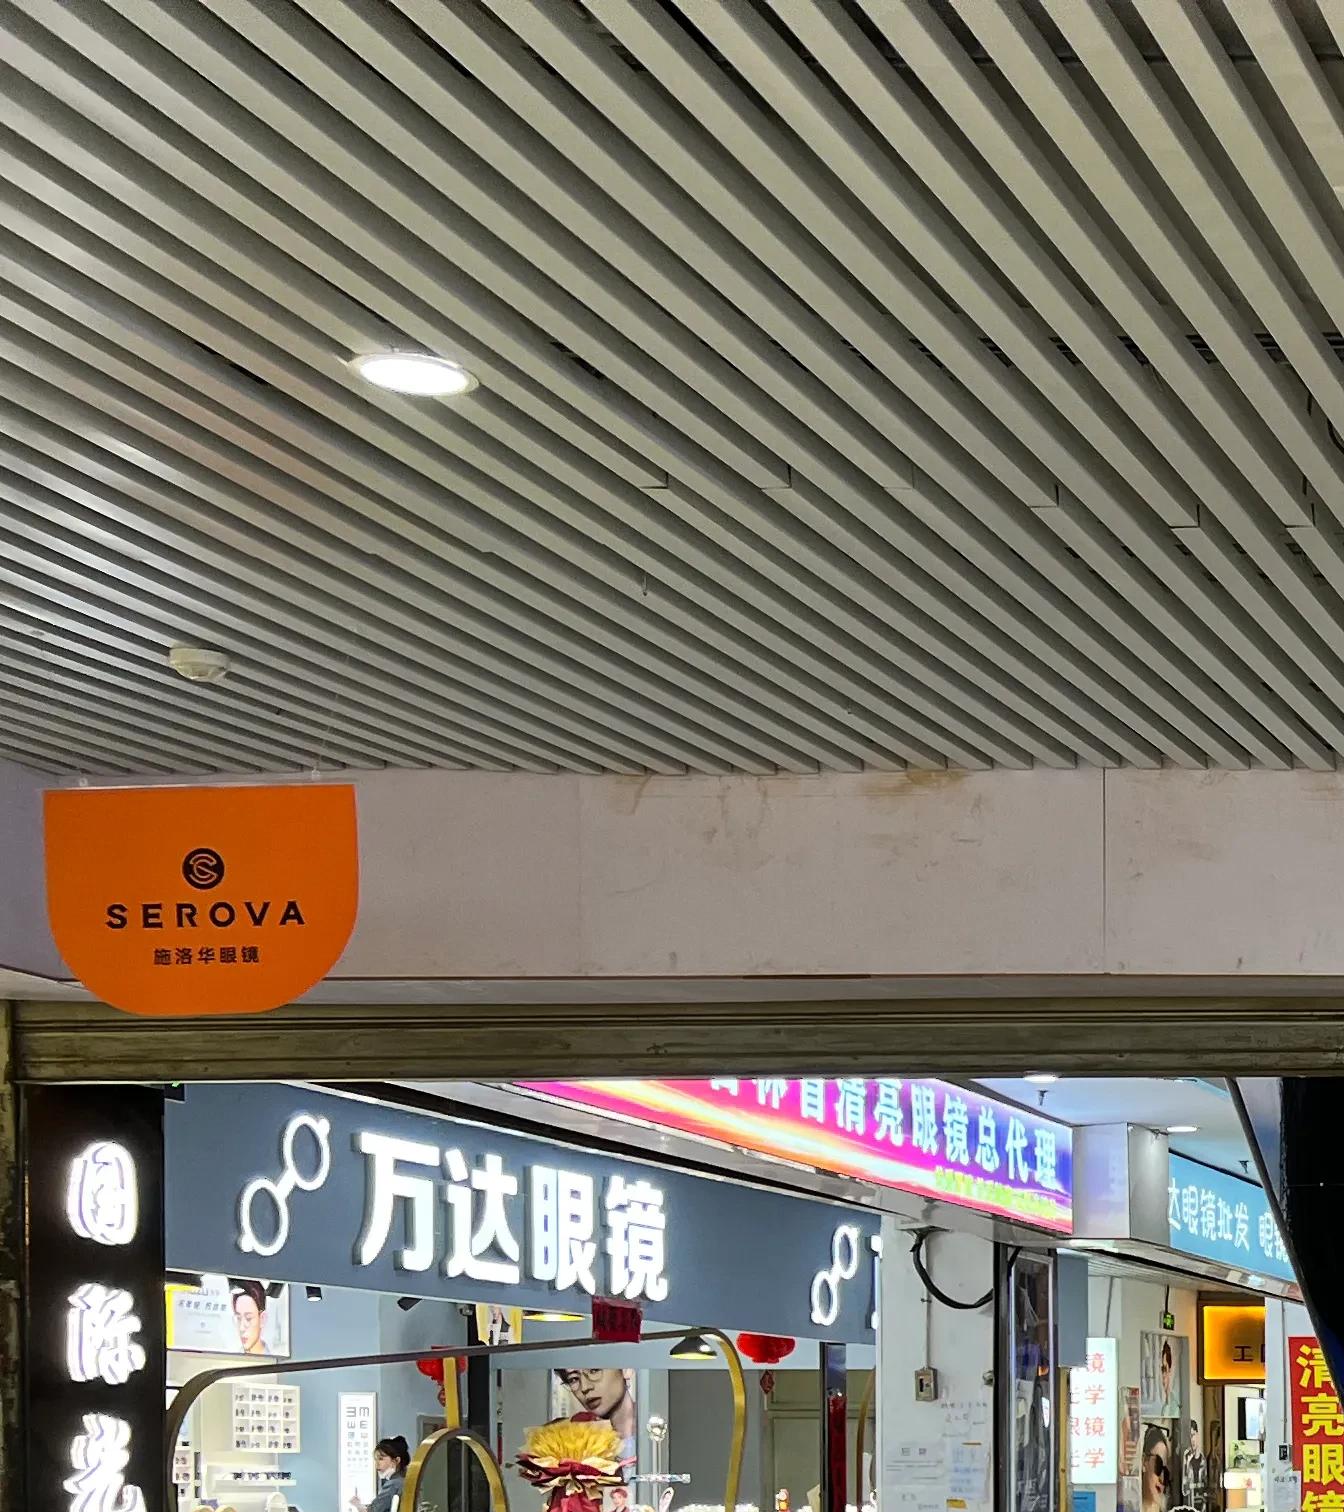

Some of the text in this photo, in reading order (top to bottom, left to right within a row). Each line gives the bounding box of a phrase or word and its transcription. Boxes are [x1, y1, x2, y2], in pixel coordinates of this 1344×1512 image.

[105, 900, 305, 930] SEROVA
[153, 945, 260, 966] 施洛华眼镜
[354, 1131, 669, 1302] 万达眼镜
